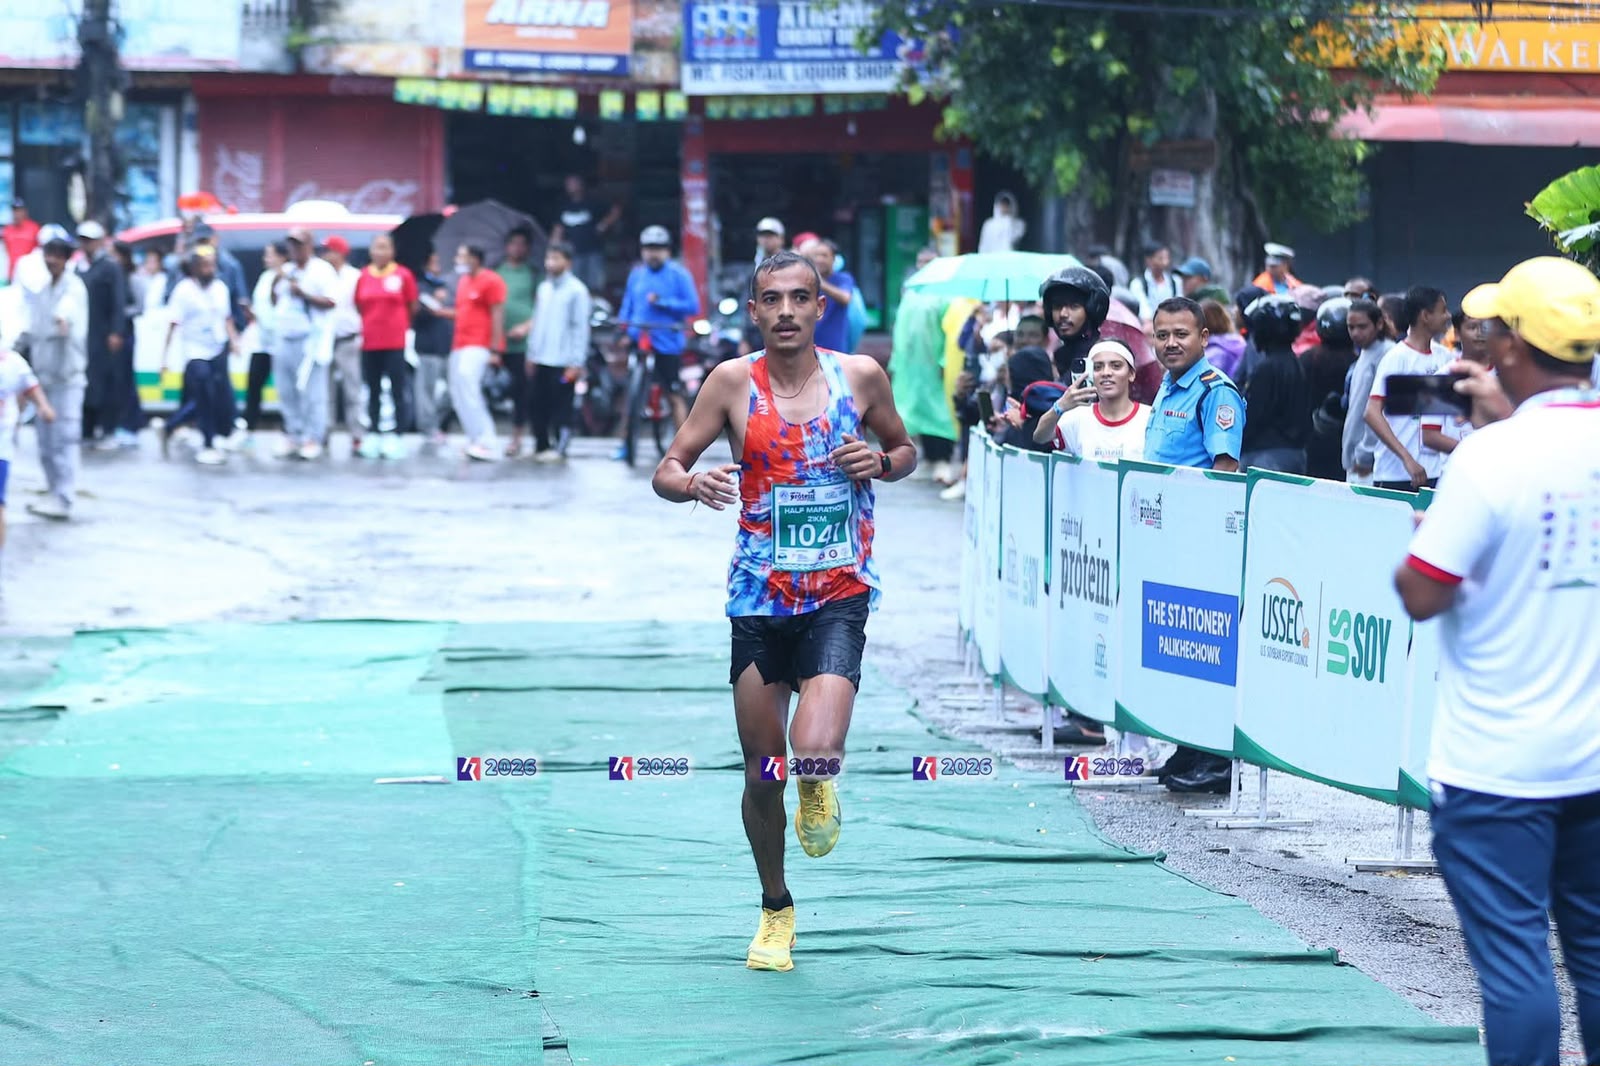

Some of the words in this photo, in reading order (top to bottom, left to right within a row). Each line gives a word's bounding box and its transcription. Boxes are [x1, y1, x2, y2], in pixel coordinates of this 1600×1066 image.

[1439, 20, 1600, 69] WALKE
[784, 506, 805, 514] HALF
[806, 503, 846, 514] MARATHON
[807, 515, 827, 523] 21KM
[1140, 506, 1162, 521] protein
[787, 521, 841, 547] 1041
[1147, 599, 1166, 626] THE
[1168, 602, 1231, 638] STATIONERY
[1261, 593, 1303, 647] USSEC
[1158, 635, 1221, 666] PALIKHECHOWK
[1327, 608, 1351, 676] US
[1351, 612, 1392, 684] SOY
